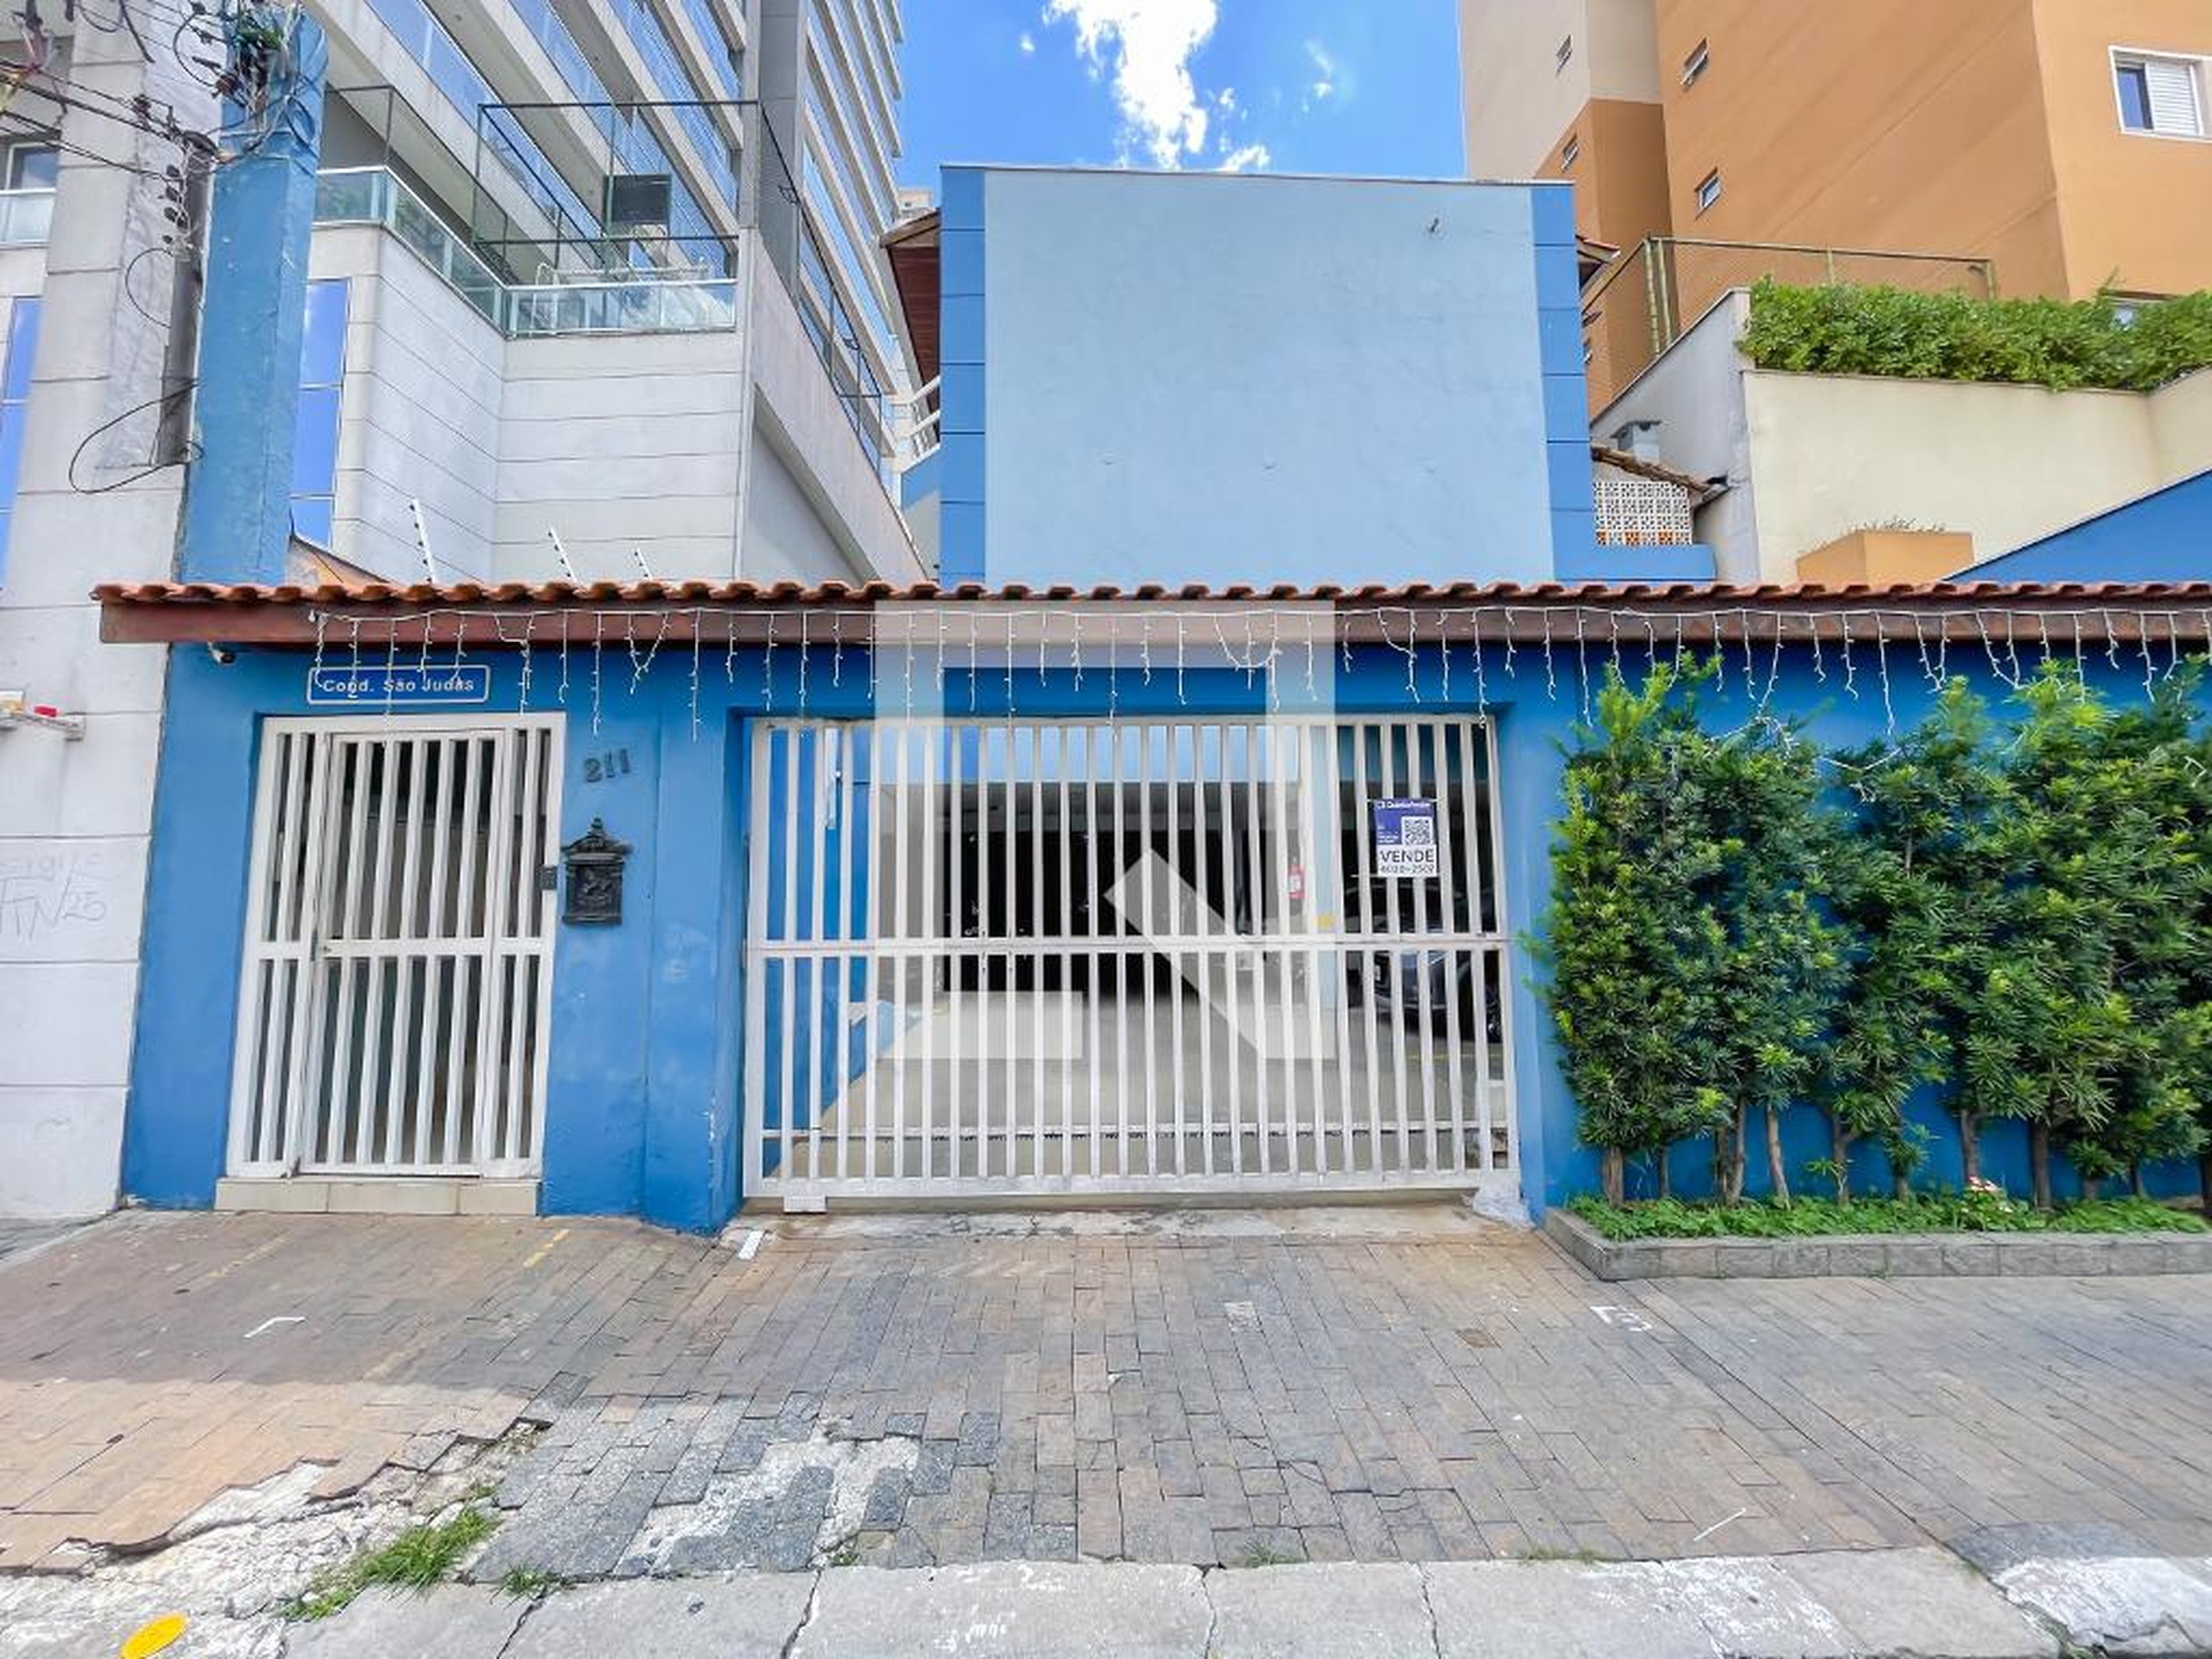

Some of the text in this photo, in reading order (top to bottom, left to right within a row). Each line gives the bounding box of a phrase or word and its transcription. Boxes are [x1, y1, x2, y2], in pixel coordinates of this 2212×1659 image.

[422, 677, 475, 692] Judas
[584, 747, 631, 783] 211
[1379, 849, 1435, 863] VENDE
